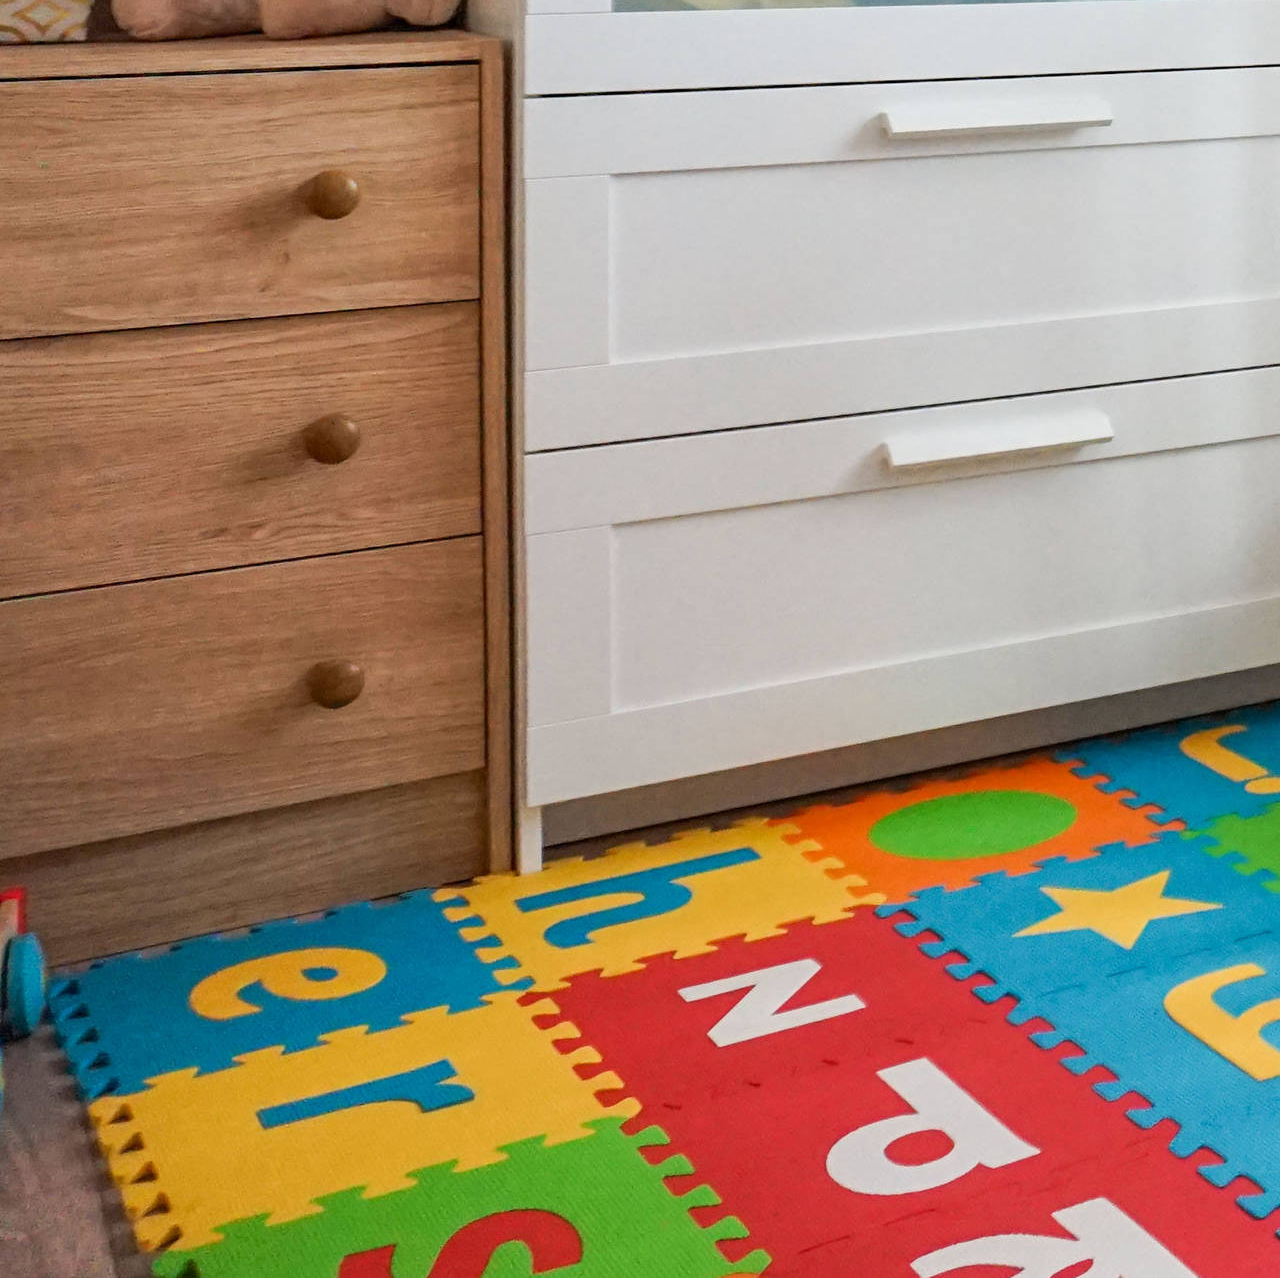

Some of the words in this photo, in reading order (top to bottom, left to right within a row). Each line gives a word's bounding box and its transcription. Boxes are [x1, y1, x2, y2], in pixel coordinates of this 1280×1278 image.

[515, 847, 760, 948] h
[189, 947, 388, 1020] e
[255, 1058, 476, 1130] r
[826, 1057, 1041, 1196] p
